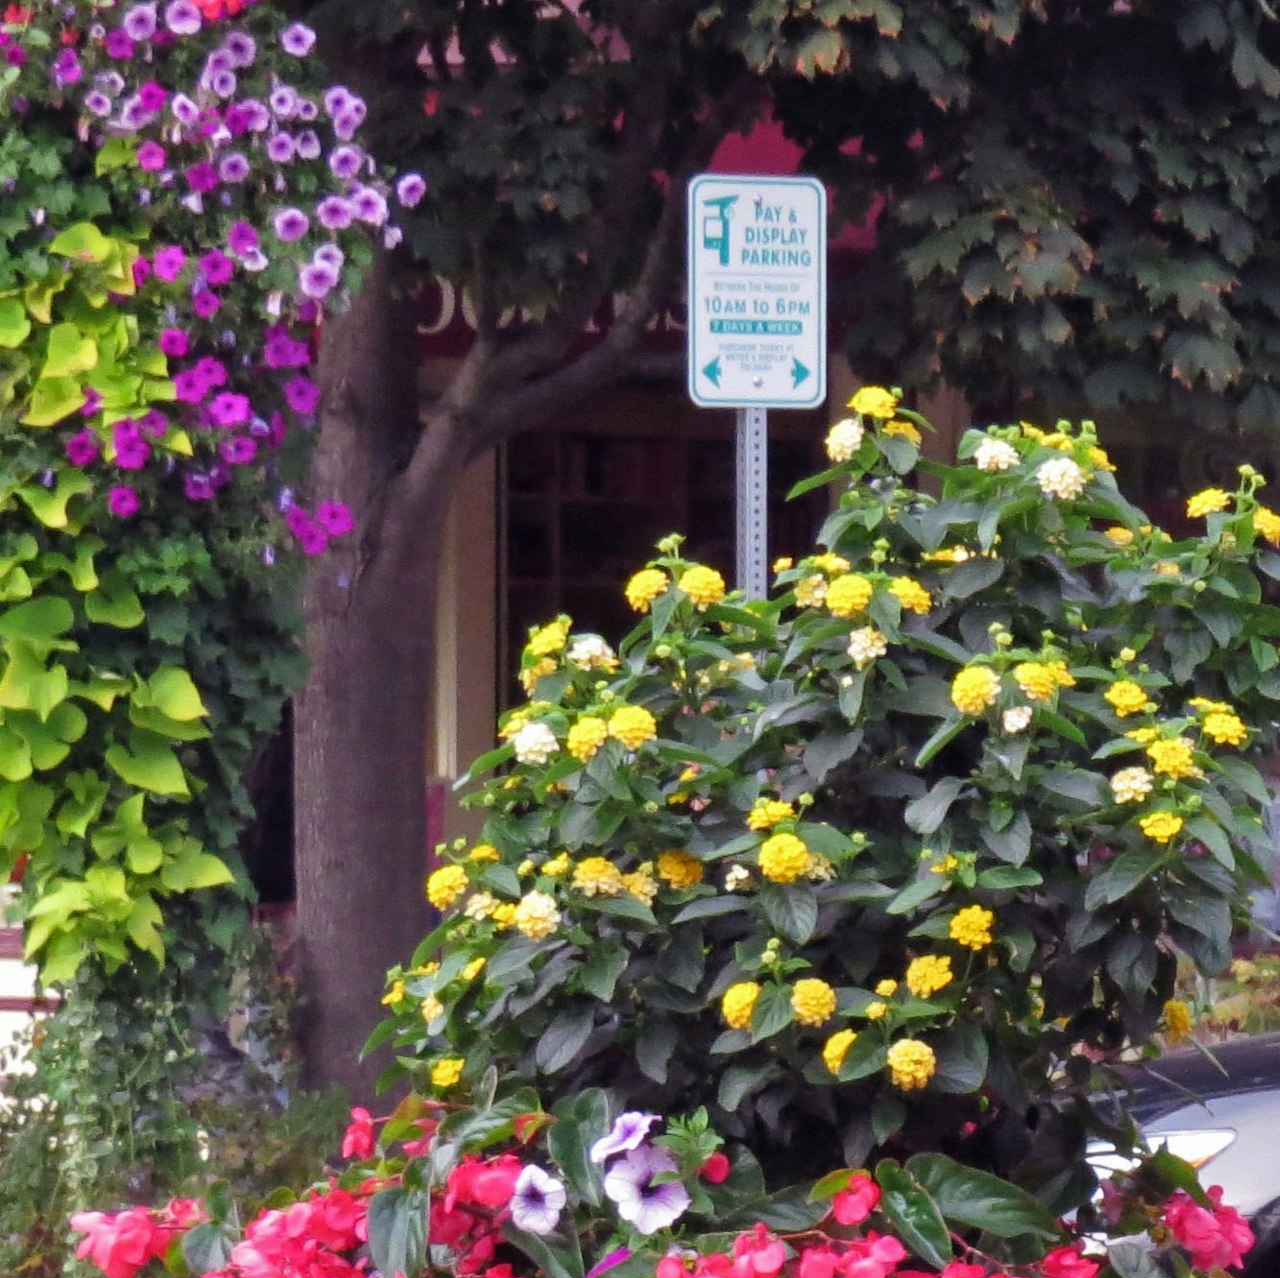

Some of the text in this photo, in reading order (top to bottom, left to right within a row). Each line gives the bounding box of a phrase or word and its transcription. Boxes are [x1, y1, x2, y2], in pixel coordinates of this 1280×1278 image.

[755, 205, 797, 223] PAY &
[745, 227, 807, 244] DISPLAY
[741, 249, 811, 266] PARKING
[753, 299, 769, 314] to
[723, 320, 753, 332] DAYS
